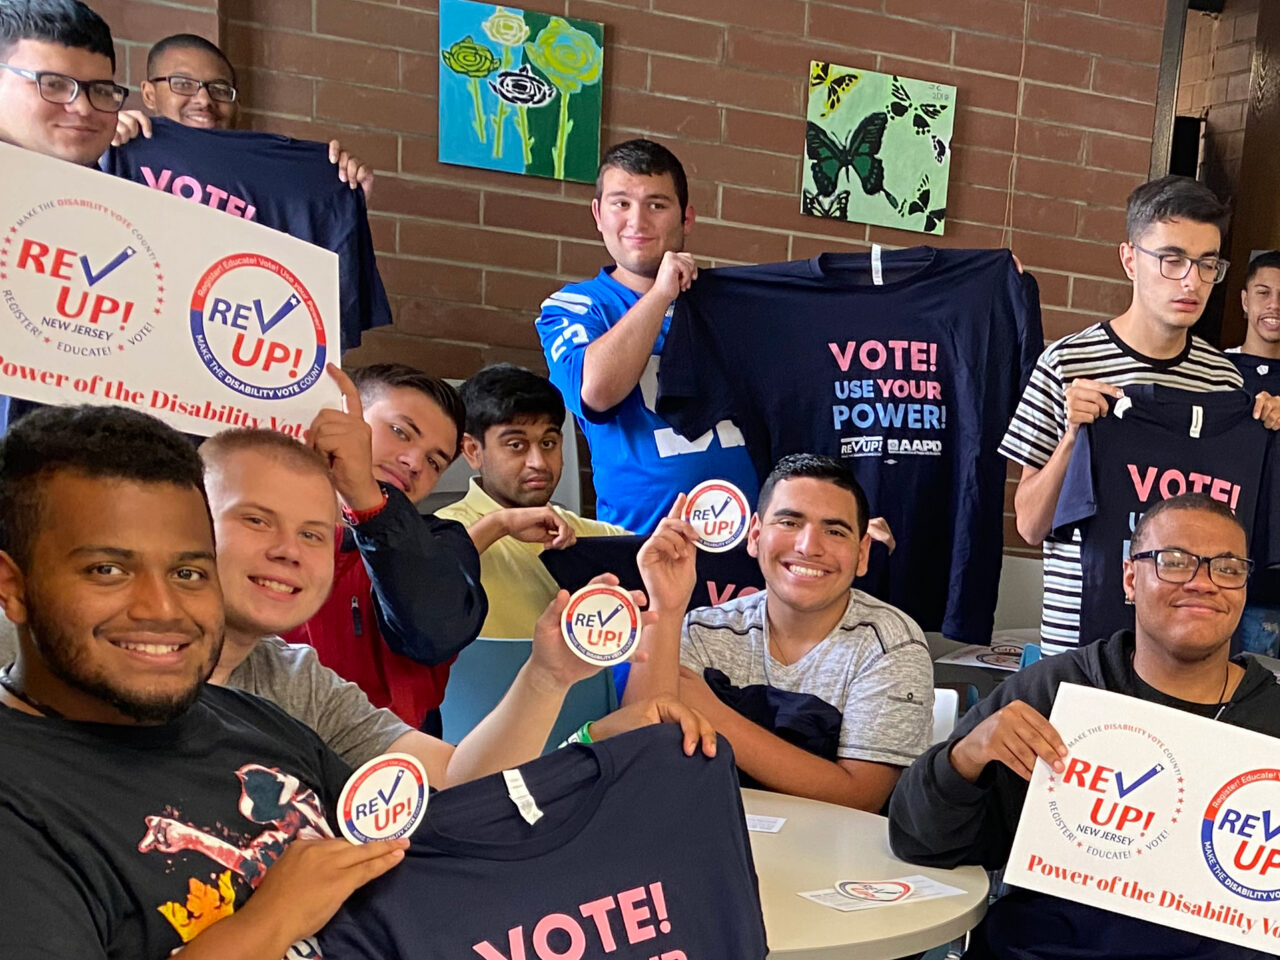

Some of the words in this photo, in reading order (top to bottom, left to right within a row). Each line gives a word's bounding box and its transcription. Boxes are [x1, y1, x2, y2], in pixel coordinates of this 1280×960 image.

[16, 208, 38, 227] MAKE
[38, 201, 55, 211] THE
[57, 199, 109, 214] DISABILITY
[110, 210, 132, 229] VOTE
[258, 257, 279, 272] Vote!
[2, 289, 43, 337] REGISTER!
[57, 341, 112, 357] EDUCATE!
[128, 321, 155, 346] VOTE!
[56, 285, 134, 331] UP!
[41, 316, 71, 331] NEW
[71, 323, 113, 341] JERSEY
[195, 334, 212, 361] MAKE
[209, 361, 226, 378] THE
[224, 376, 275, 398] DISABILITY
[275, 385, 300, 398] VOTE
[299, 364, 322, 389] COUNT
[232, 332, 303, 379] UP!
[828, 339, 938, 372] VOTE!
[0, 356, 69, 390] ower
[73, 375, 104, 396] of
[103, 381, 145, 405] the
[149, 390, 264, 428] Disability
[834, 379, 875, 400] USE
[876, 379, 942, 400] YOUR
[832, 402, 946, 431] POWER!
[899, 438, 942, 451] AAPD
[704, 520, 735, 536] UP!
[587, 629, 623, 648] UP!
[1067, 734, 1087, 748] MAKE
[1087, 725, 1103, 735] THE
[1103, 723, 1147, 736] DISABILITY
[1147, 733, 1164, 749] VOTE
[1212, 779, 1241, 809] Register!
[1240, 771, 1276, 784] Educate!
[374, 797, 412, 831] UP!
[1048, 800, 1077, 842] REGISTER!
[1086, 845, 1132, 860] EDUCATE!
[1145, 829, 1170, 851] VOTE!
[1090, 797, 1156, 837] UP!
[1076, 824, 1100, 837] NEW
[1100, 831, 1135, 847] JERSEY
[1204, 841, 1217, 866] MAKE
[1213, 865, 1227, 882] THE
[1224, 879, 1269, 900] DISABILITY
[1026, 854, 1095, 887] Power
[1096, 875, 1123, 896] of
[1121, 879, 1155, 904] the
[1158, 889, 1259, 935] Disability
